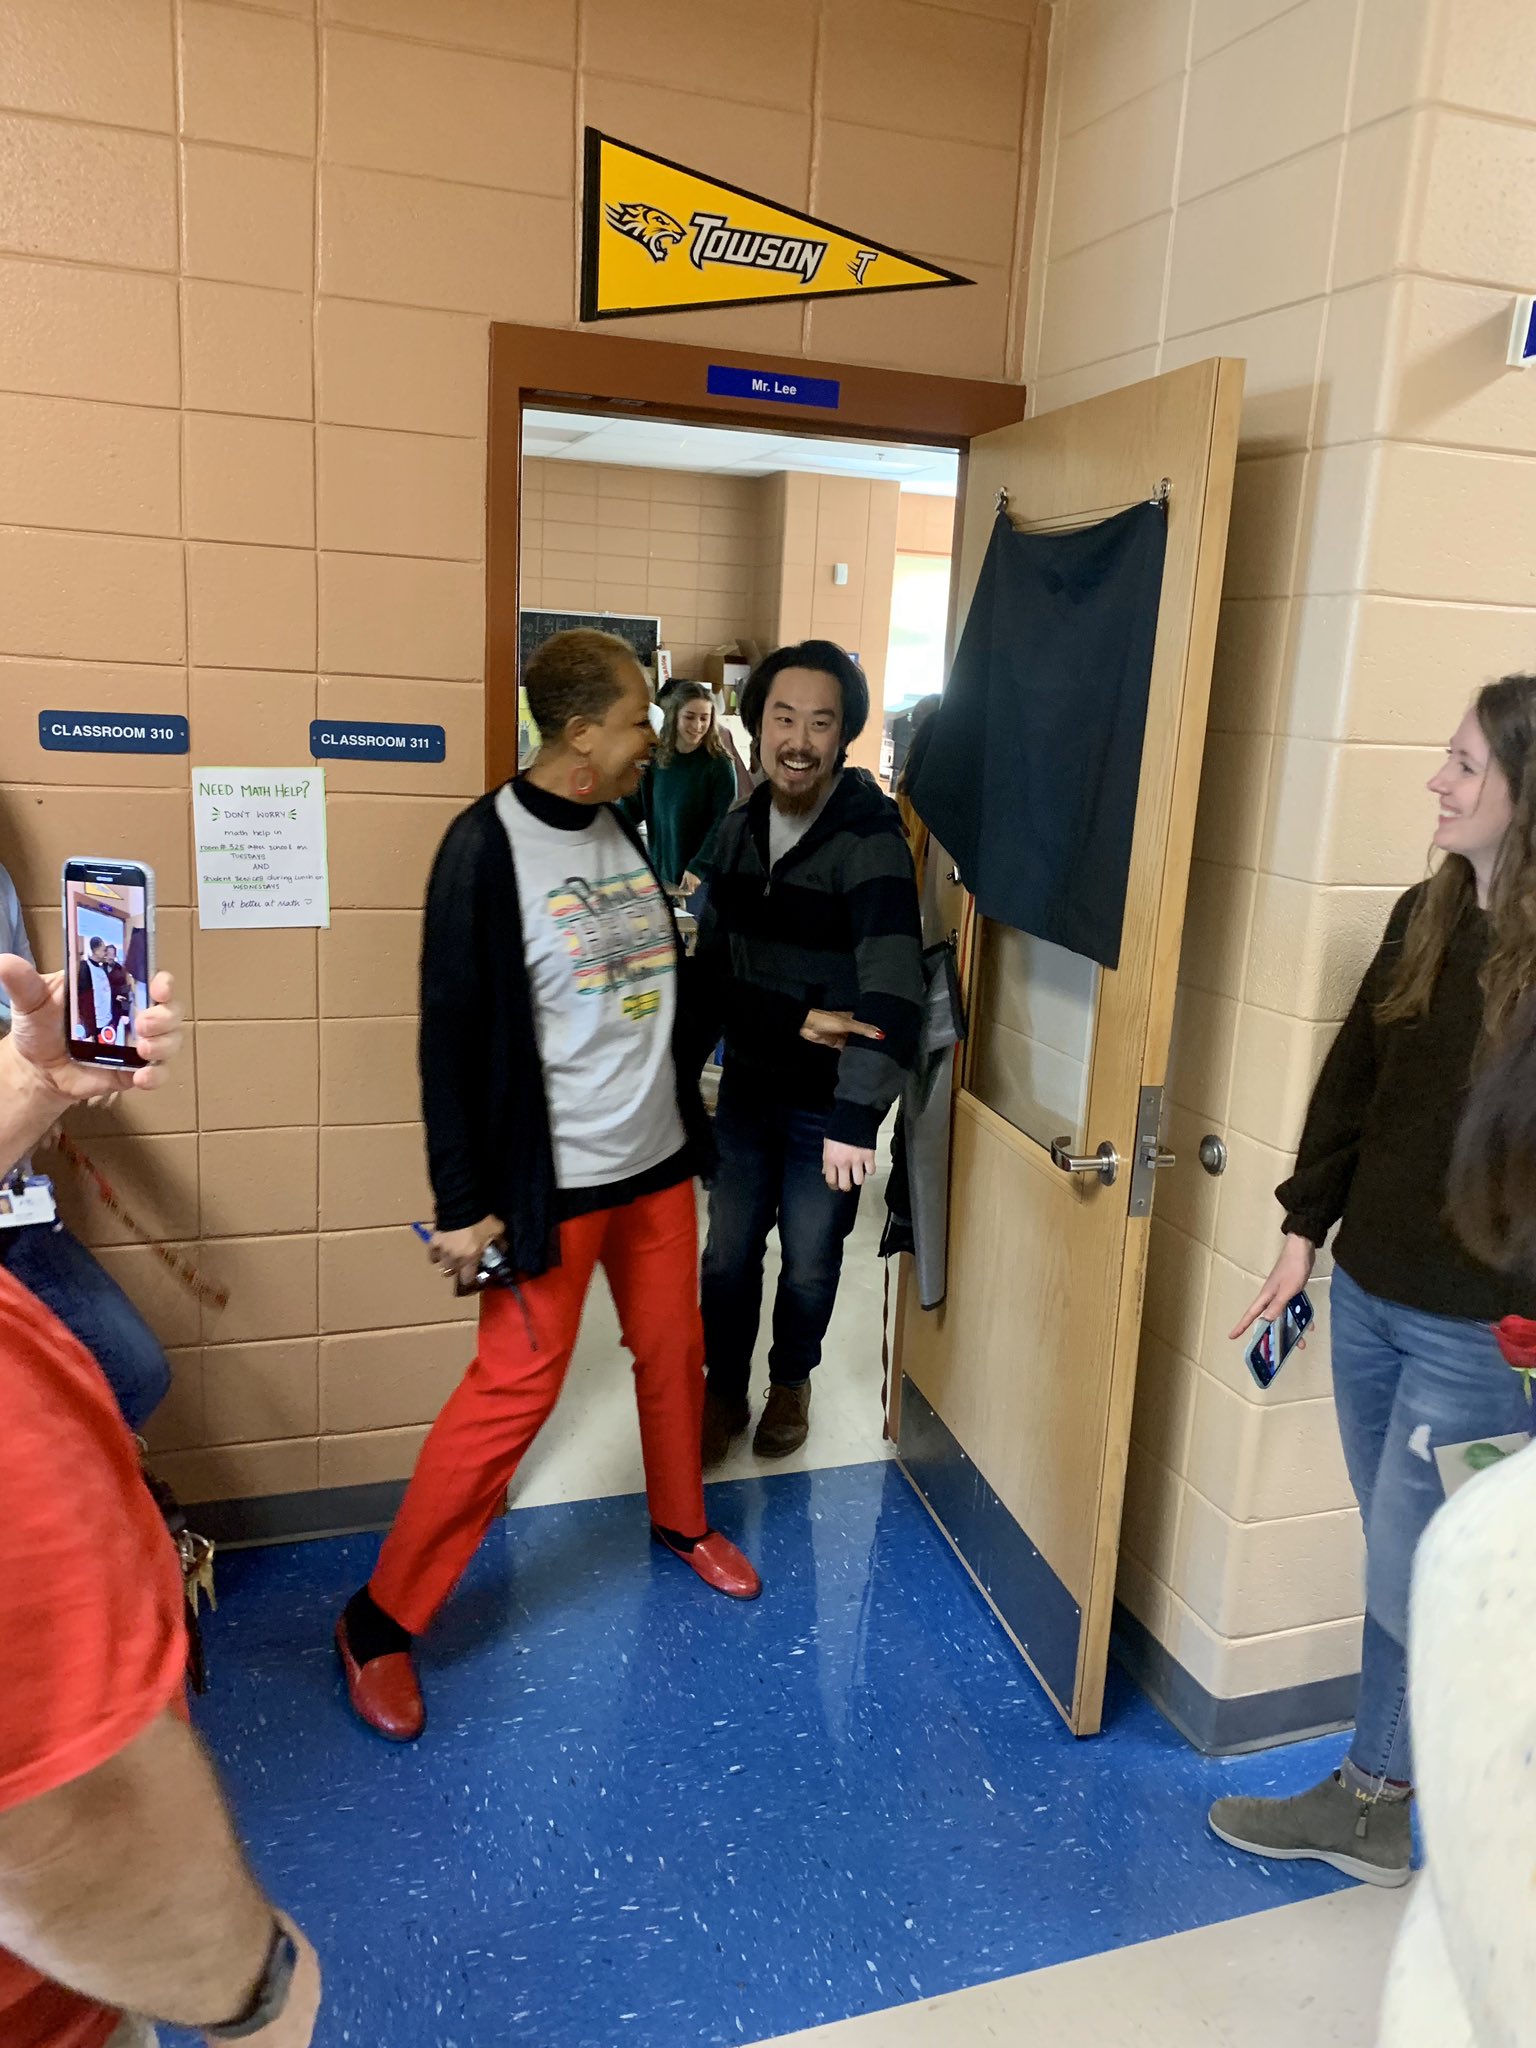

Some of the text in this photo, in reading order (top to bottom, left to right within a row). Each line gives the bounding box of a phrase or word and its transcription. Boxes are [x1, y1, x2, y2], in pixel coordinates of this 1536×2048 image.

[689, 212, 828, 284] TOWSON
[752, 379, 797, 395] Mr. Lee
[51, 724, 174, 740] CLASSROOM 310
[320, 733, 430, 749] CLASSROOM 311
[200, 780, 310, 799] NEED MATH HELP?
[253, 829, 271, 838] help
[266, 874, 293, 884] during
[221, 900, 235, 915] get
[240, 900, 262, 908] better
[264, 899, 274, 907] at
